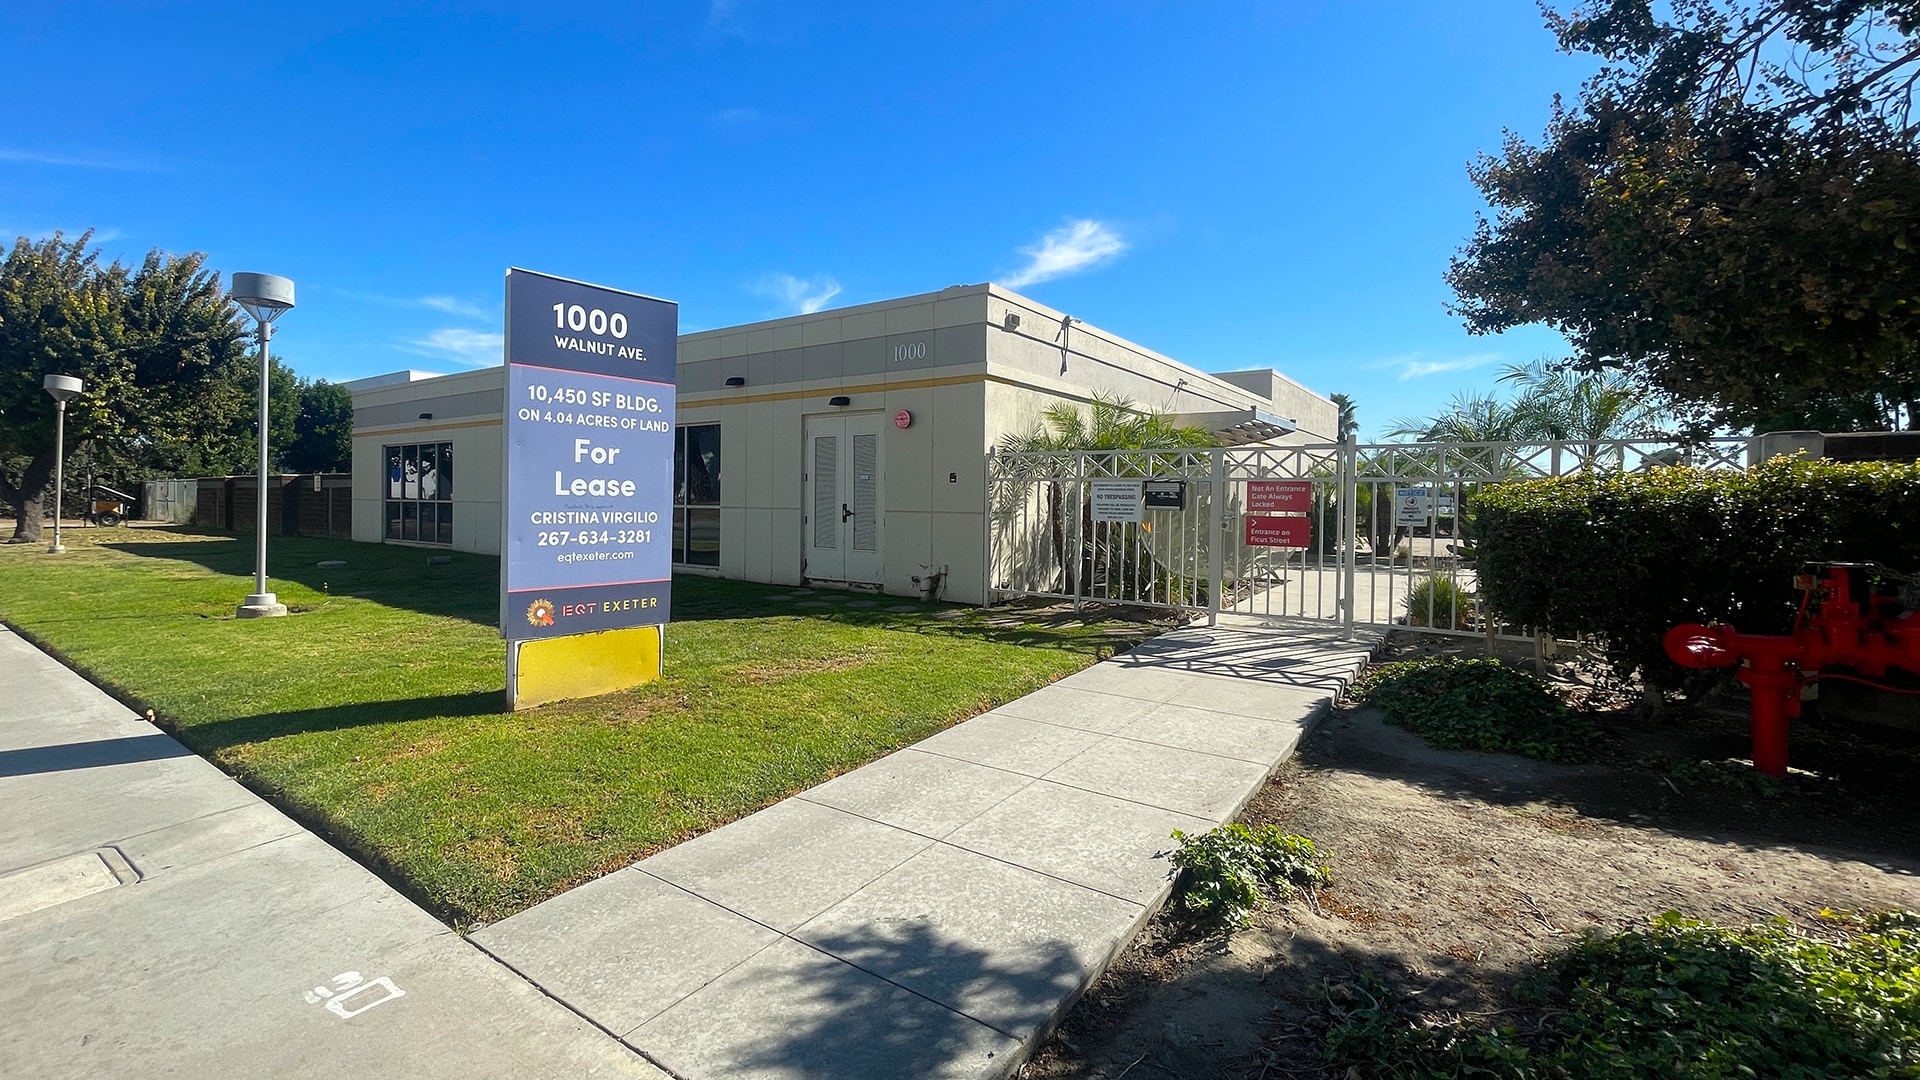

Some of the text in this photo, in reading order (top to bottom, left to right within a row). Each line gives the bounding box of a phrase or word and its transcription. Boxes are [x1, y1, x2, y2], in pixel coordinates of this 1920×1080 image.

[552, 302, 628, 339] 1000
[554, 335, 647, 361] WALNUT AVE.
[894, 342, 926, 362] 1000
[528, 385, 662, 413] 10,450 SF BLDG.
[518, 408, 670, 433] ON 4.04 ACRES OF LAND
[574, 438, 620, 465] For
[555, 470, 636, 497] Lease
[530, 512, 658, 525] CRISTINA VIRGILIO
[537, 530, 651, 546] 267-634-3281
[557, 551, 634, 564] eqtexeter.com
[562, 597, 658, 617] EQT EXETER
